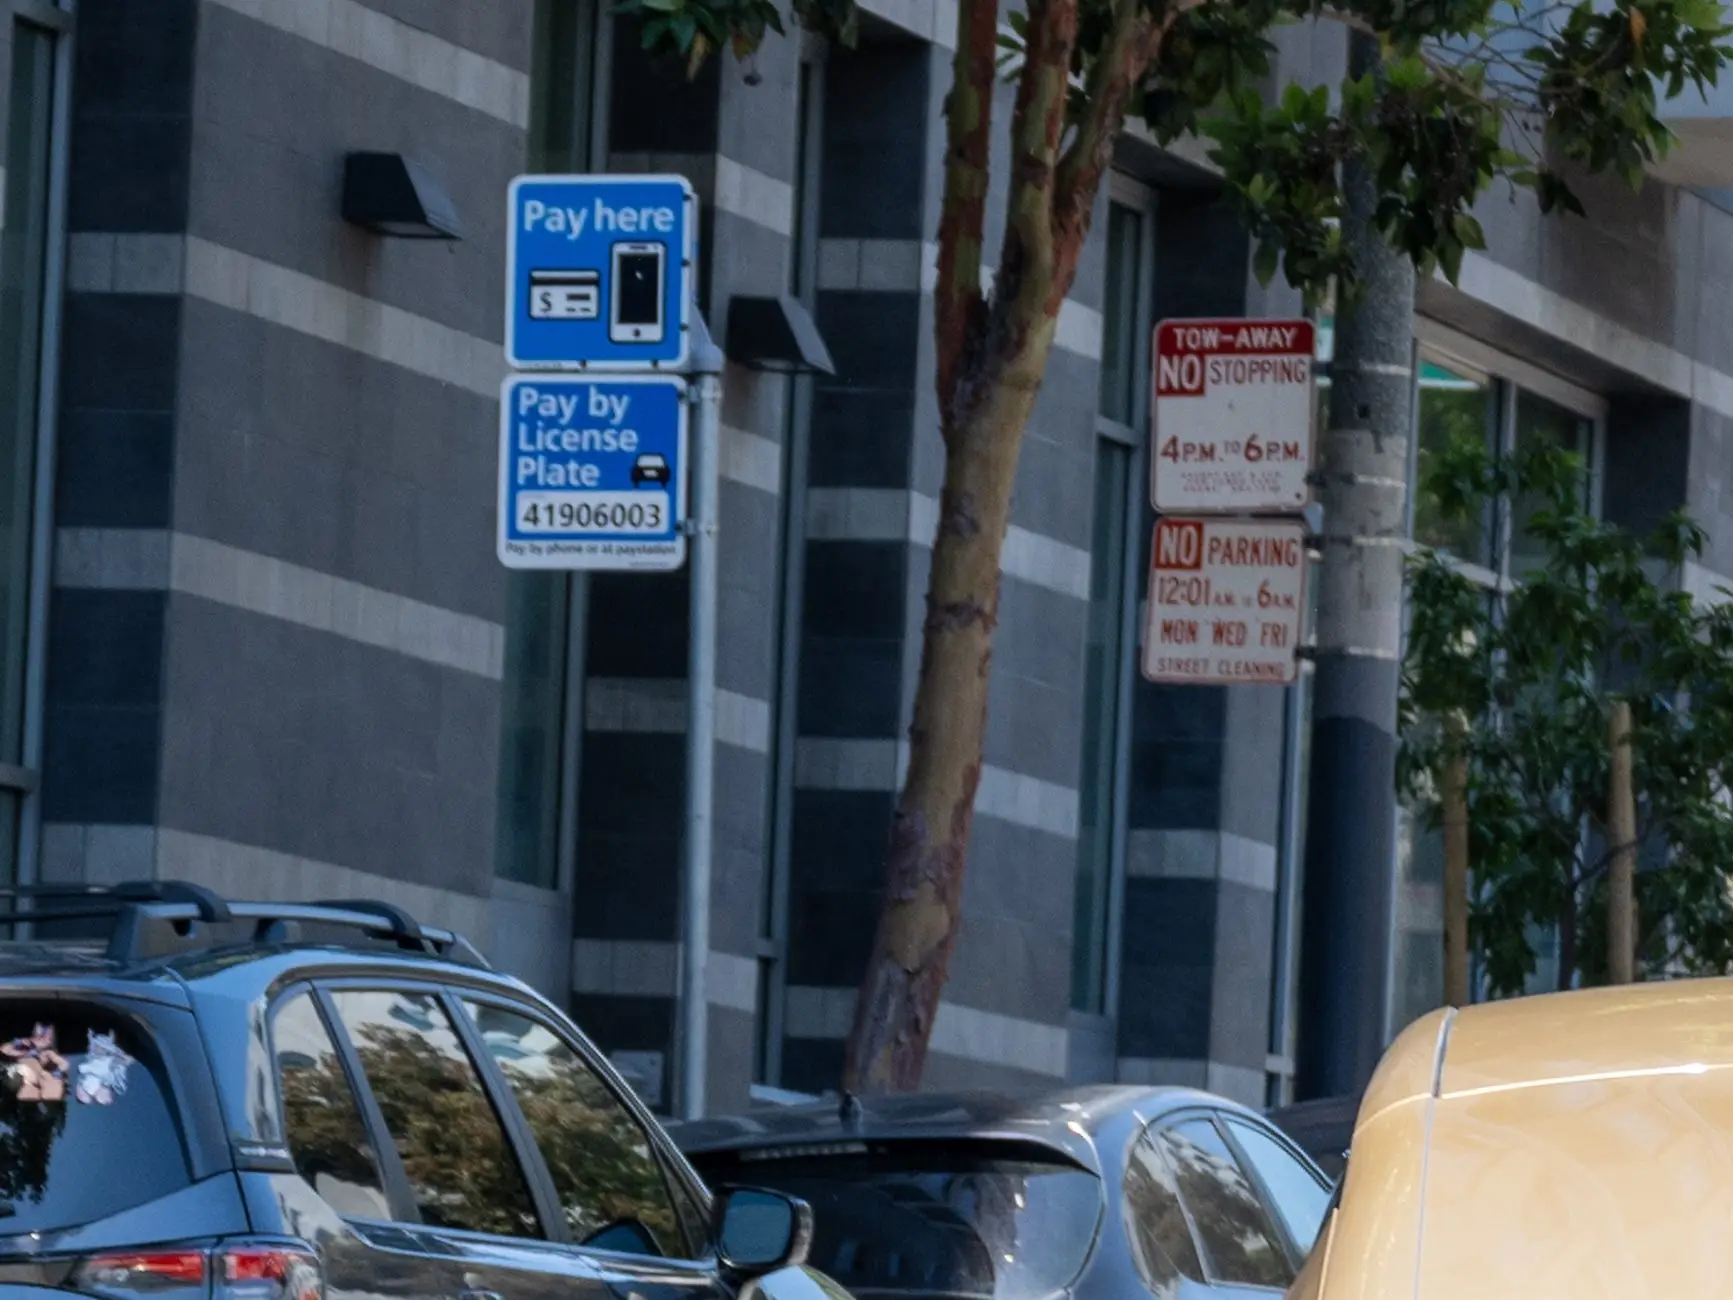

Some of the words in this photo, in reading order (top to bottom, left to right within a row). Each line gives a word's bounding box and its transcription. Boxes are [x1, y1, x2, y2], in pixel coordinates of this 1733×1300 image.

[523, 199, 588, 240] Pay
[594, 197, 675, 232] here
[1173, 327, 1297, 349] TOW-AWAY
[1159, 354, 1200, 391] NO
[1209, 358, 1307, 385] STOPPING
[518, 386, 579, 425] Pay
[588, 384, 631, 425] by
[518, 421, 639, 452] License
[516, 455, 601, 487] Plate
[523, 502, 661, 527] 41906003
[546, 542, 582, 556] phone
[1159, 524, 1199, 564] NO
[1208, 537, 1298, 567] PARKING
[1160, 618, 1199, 646] MON
[1211, 619, 1247, 646] WED
[1260, 621, 1288, 648] FRI
[1158, 657, 1210, 674] STREET
[1217, 659, 1285, 678] CLEANING
